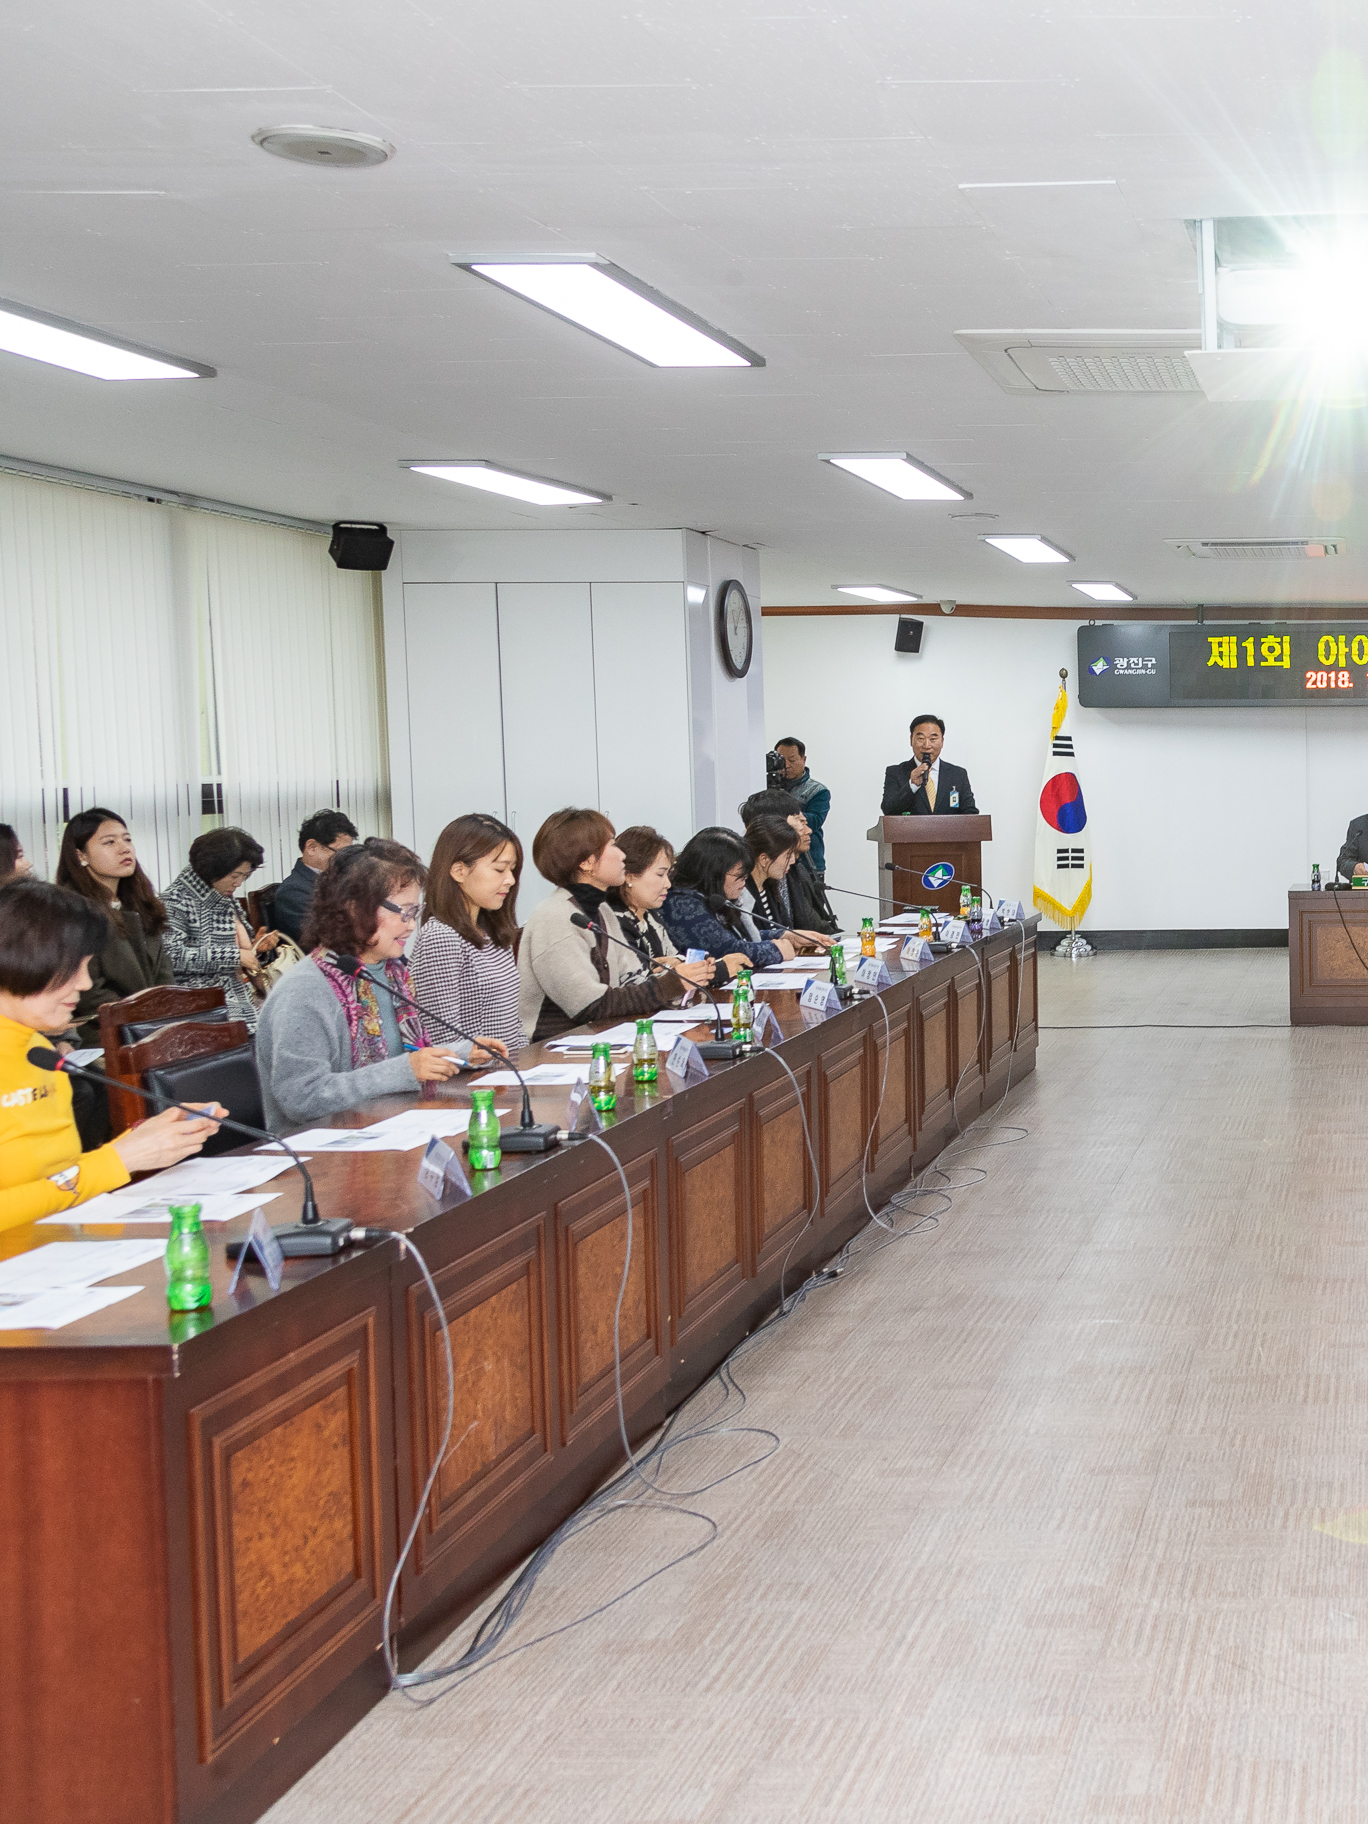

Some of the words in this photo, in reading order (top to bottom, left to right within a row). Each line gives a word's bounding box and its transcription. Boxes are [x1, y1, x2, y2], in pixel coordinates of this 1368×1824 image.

[1207, 635, 1290, 668] 제1회
[1113, 657, 1157, 669] 광진구
[1305, 670, 1354, 689] 2018.
